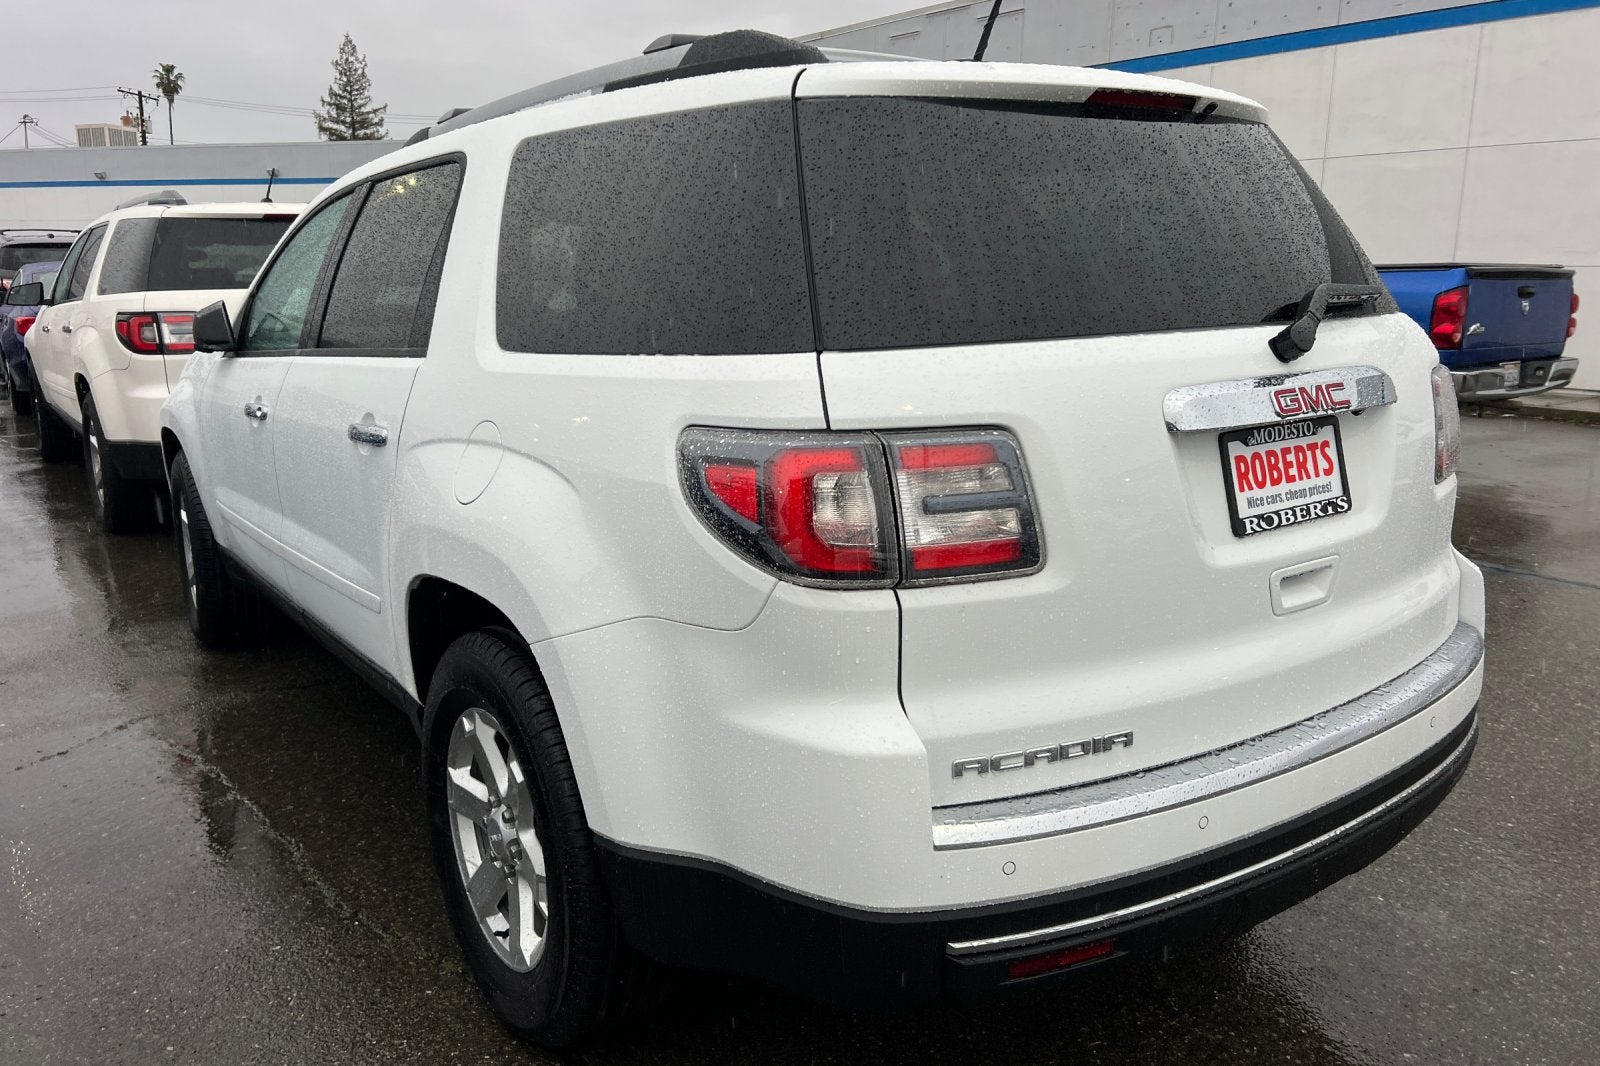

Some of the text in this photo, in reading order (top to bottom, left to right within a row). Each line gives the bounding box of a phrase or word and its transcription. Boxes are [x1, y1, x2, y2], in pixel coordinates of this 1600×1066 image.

[1270, 382, 1352, 417] GMC
[1252, 421, 1314, 444] MODESTO
[1234, 440, 1334, 493] ROBERTS
[1247, 481, 1332, 509] Nice cars, cheap prices!
[1242, 497, 1349, 534] ROBERTS
[952, 730, 1134, 779] ACADIA
